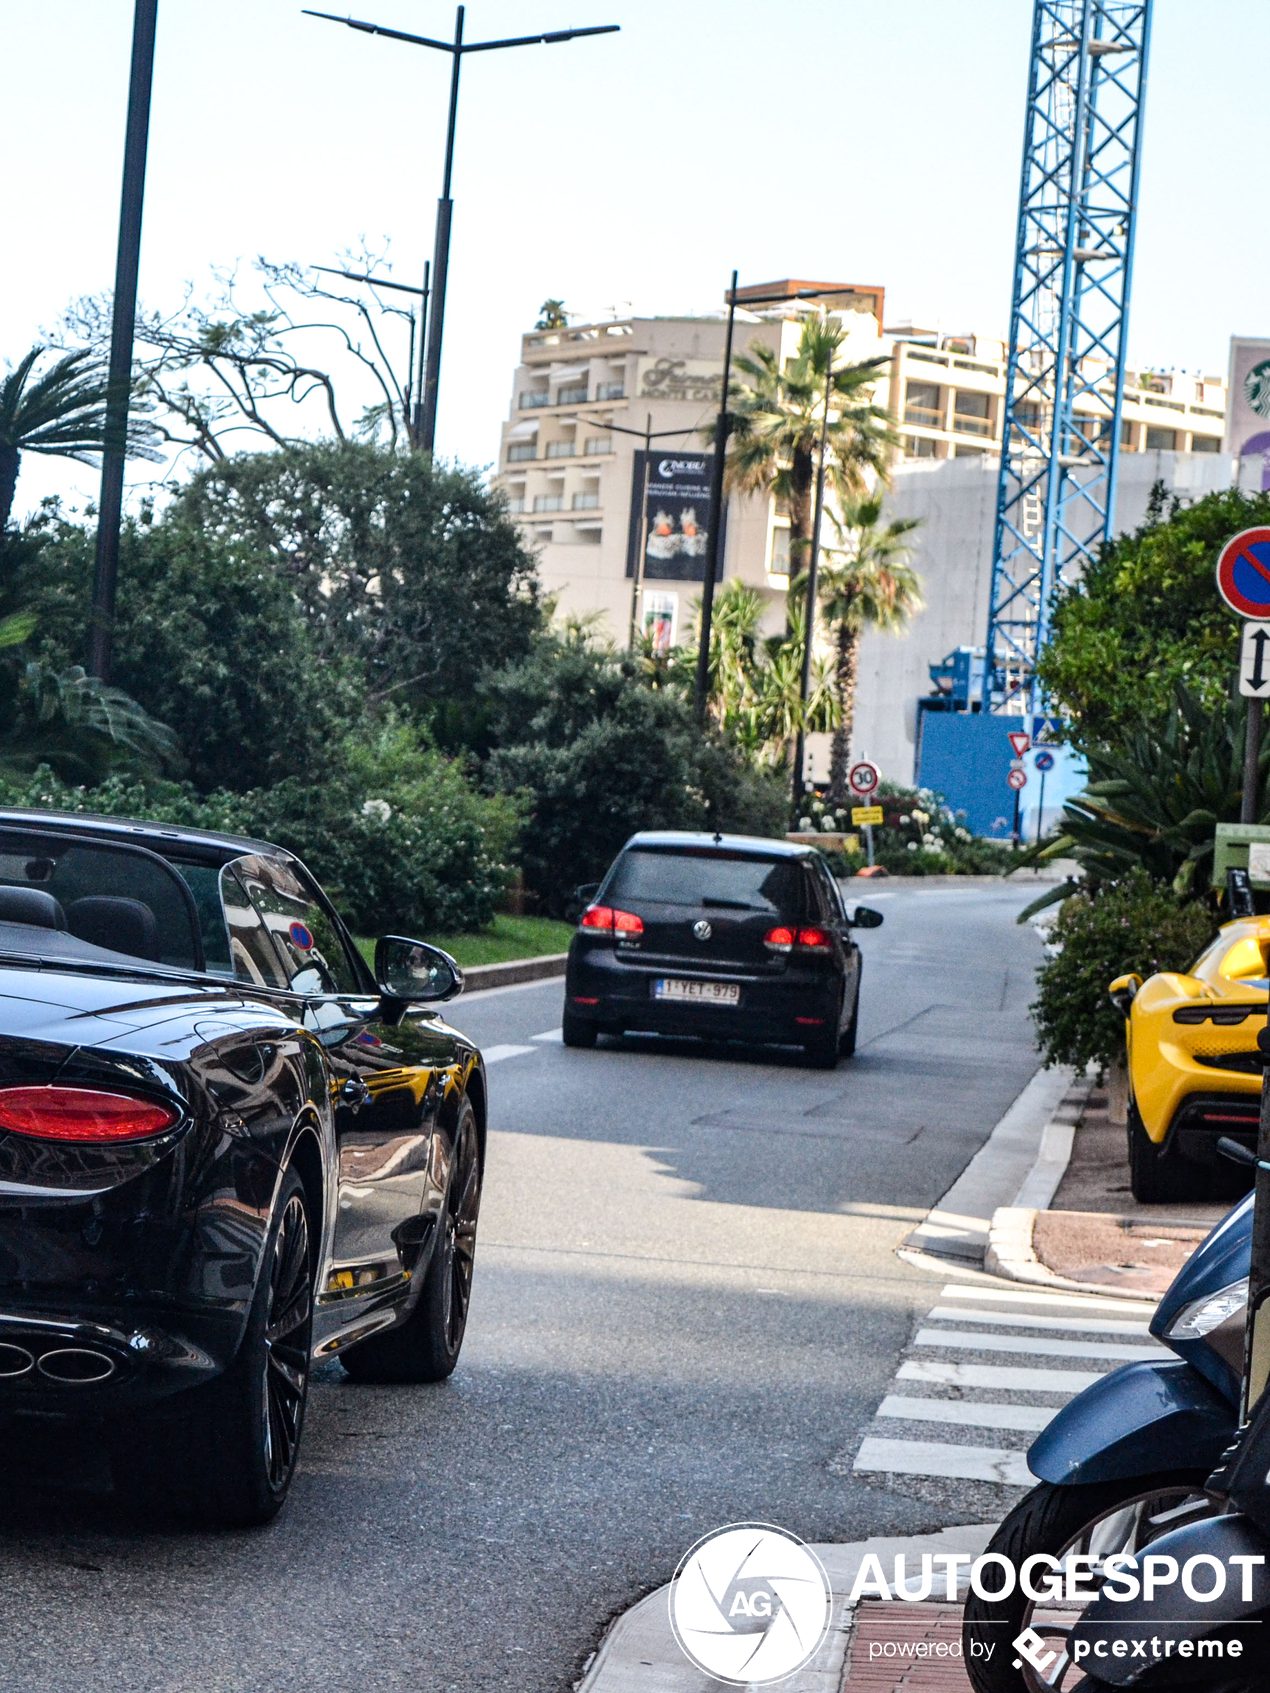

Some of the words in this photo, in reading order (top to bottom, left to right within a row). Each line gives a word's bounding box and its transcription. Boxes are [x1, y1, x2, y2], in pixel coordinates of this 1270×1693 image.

[640, 387, 687, 400] MONTE
[671, 460, 706, 471] NOBU
[854, 770, 874, 785] 30
[666, 981, 738, 998] 1-YET-979
